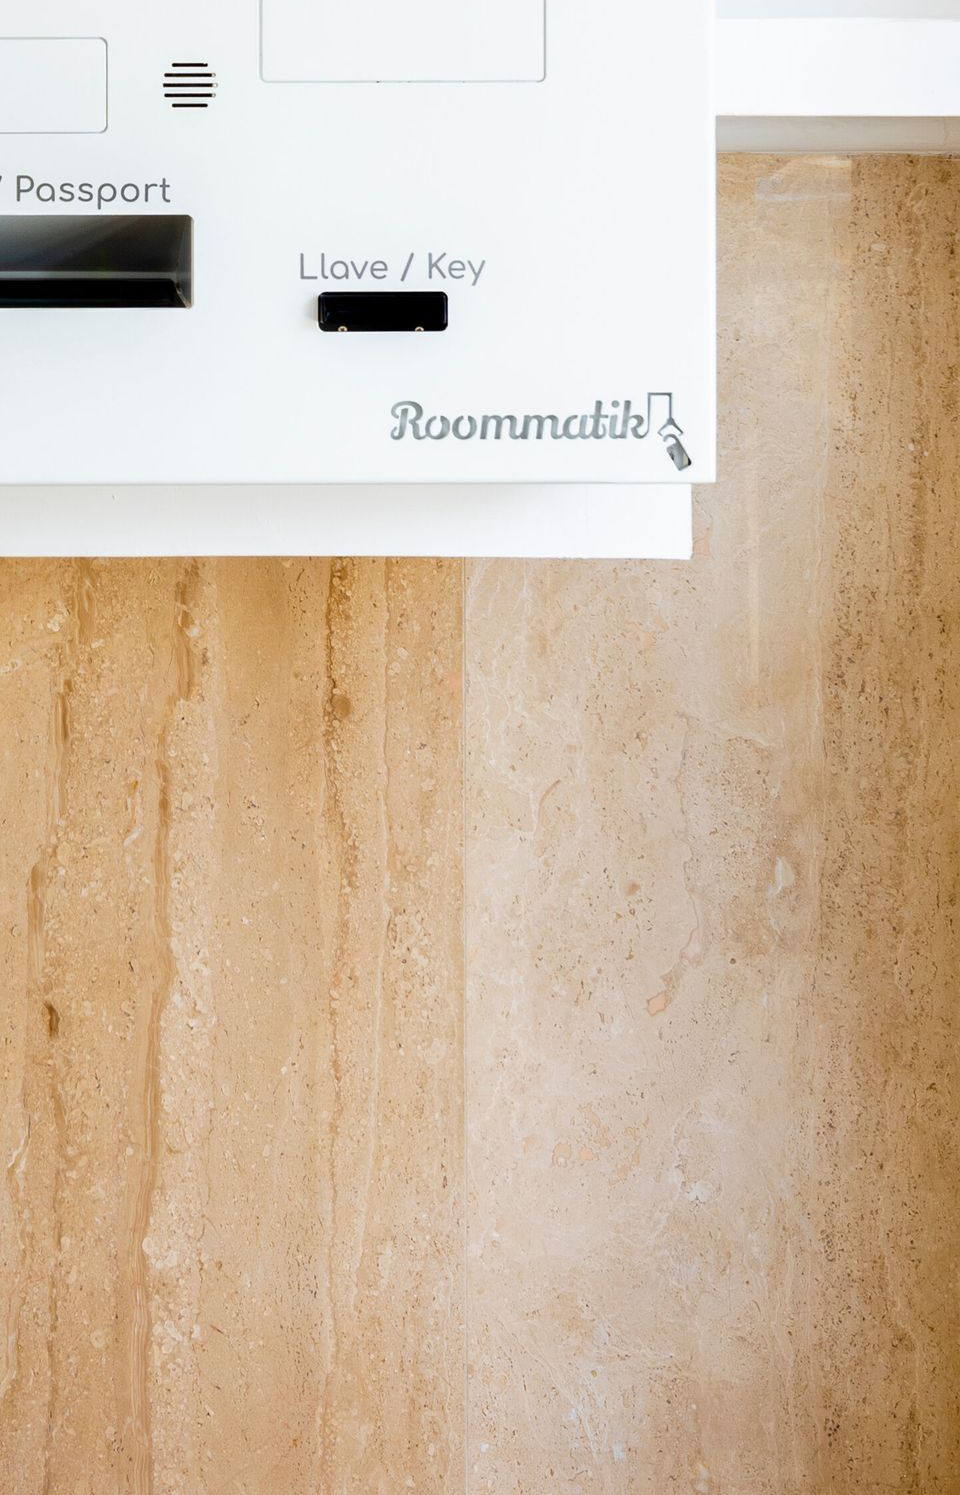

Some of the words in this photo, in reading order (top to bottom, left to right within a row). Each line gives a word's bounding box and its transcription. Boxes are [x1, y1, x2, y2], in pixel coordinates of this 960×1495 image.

[16, 174, 171, 211] Passport
[299, 252, 389, 281] Llave
[399, 252, 415, 283] /
[427, 252, 486, 287] Key
[390, 399, 647, 441] Roommatik
